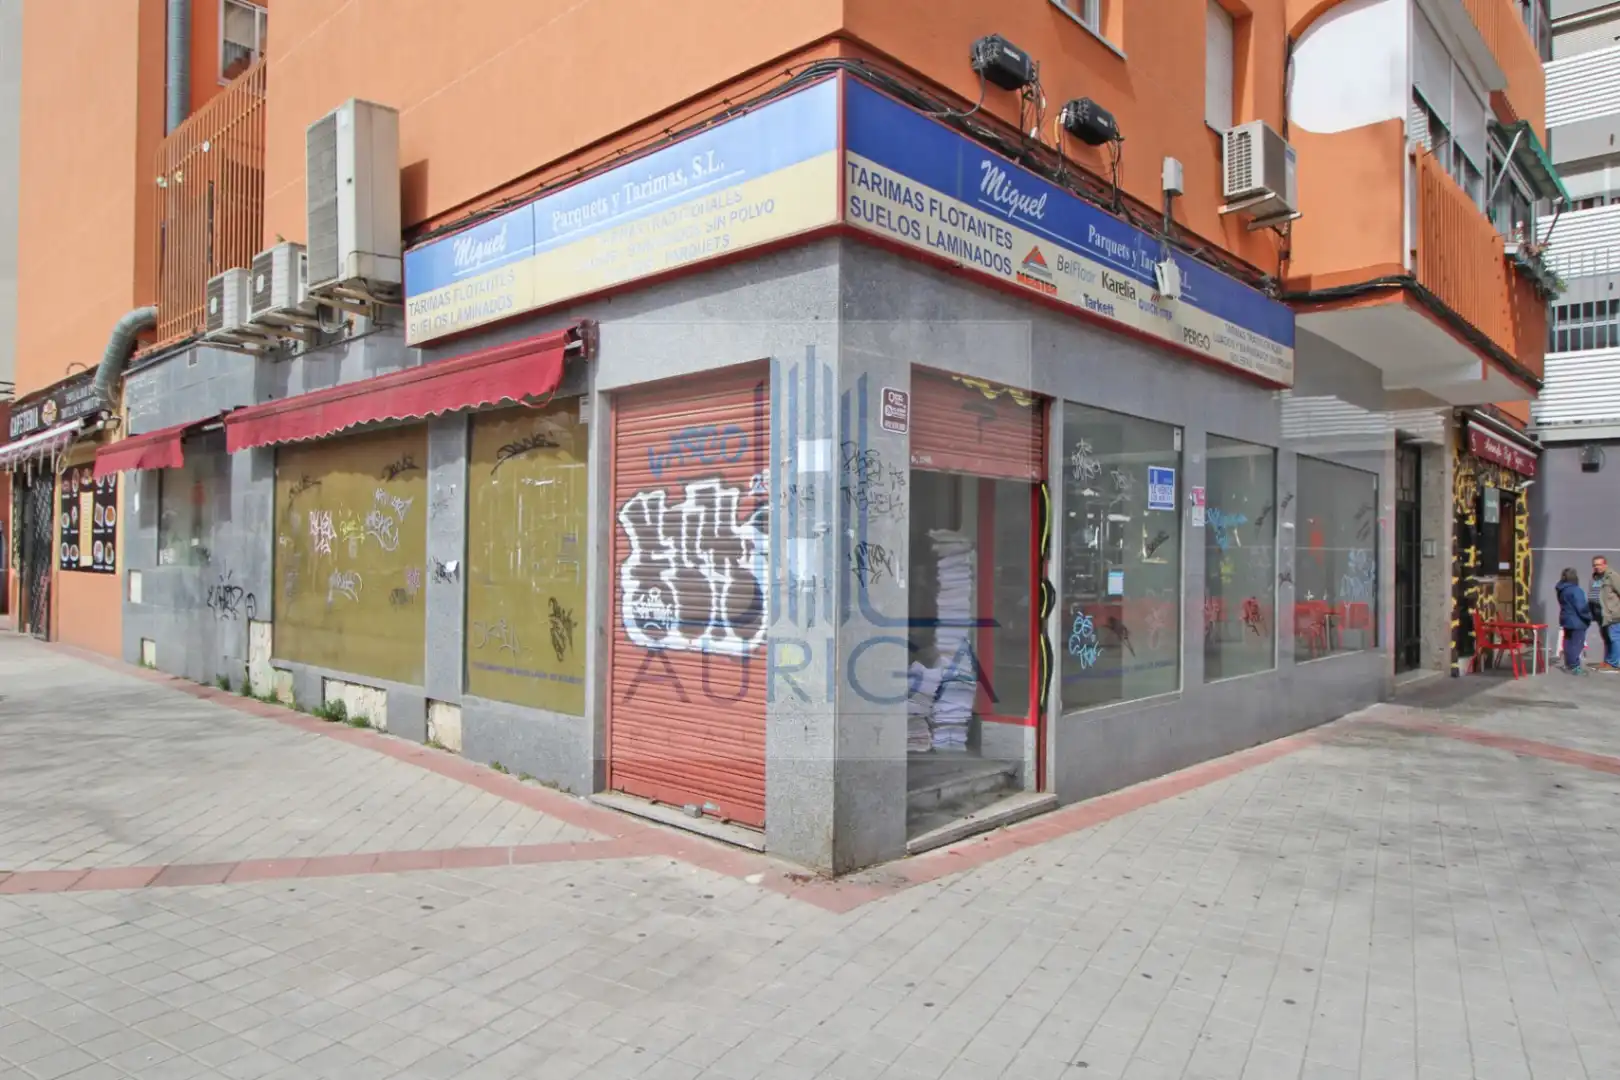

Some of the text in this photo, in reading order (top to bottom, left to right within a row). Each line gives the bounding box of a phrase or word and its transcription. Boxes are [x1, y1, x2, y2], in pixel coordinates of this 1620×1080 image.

[552, 199, 609, 232] Parquets
[611, 190, 621, 214] y
[692, 150, 725, 180] S.L.
[729, 198, 775, 225] POLVO
[847, 160, 1013, 250] TARIMAS FLOTANTES
[980, 159, 1048, 220] Miguel
[453, 220, 508, 268] Miguel
[850, 195, 1013, 276] SUELOS LAMINADOS
[1088, 223, 1130, 261] Parquets
[1131, 250, 1138, 268] y
[1056, 253, 1137, 301] BelFloor Karelia
[409, 291, 451, 317] TARIMAS
[410, 294, 513, 337] SUELOS LAMINADOS
[1083, 292, 1116, 318] Tarkett
[1183, 327, 1211, 351] PERGO
